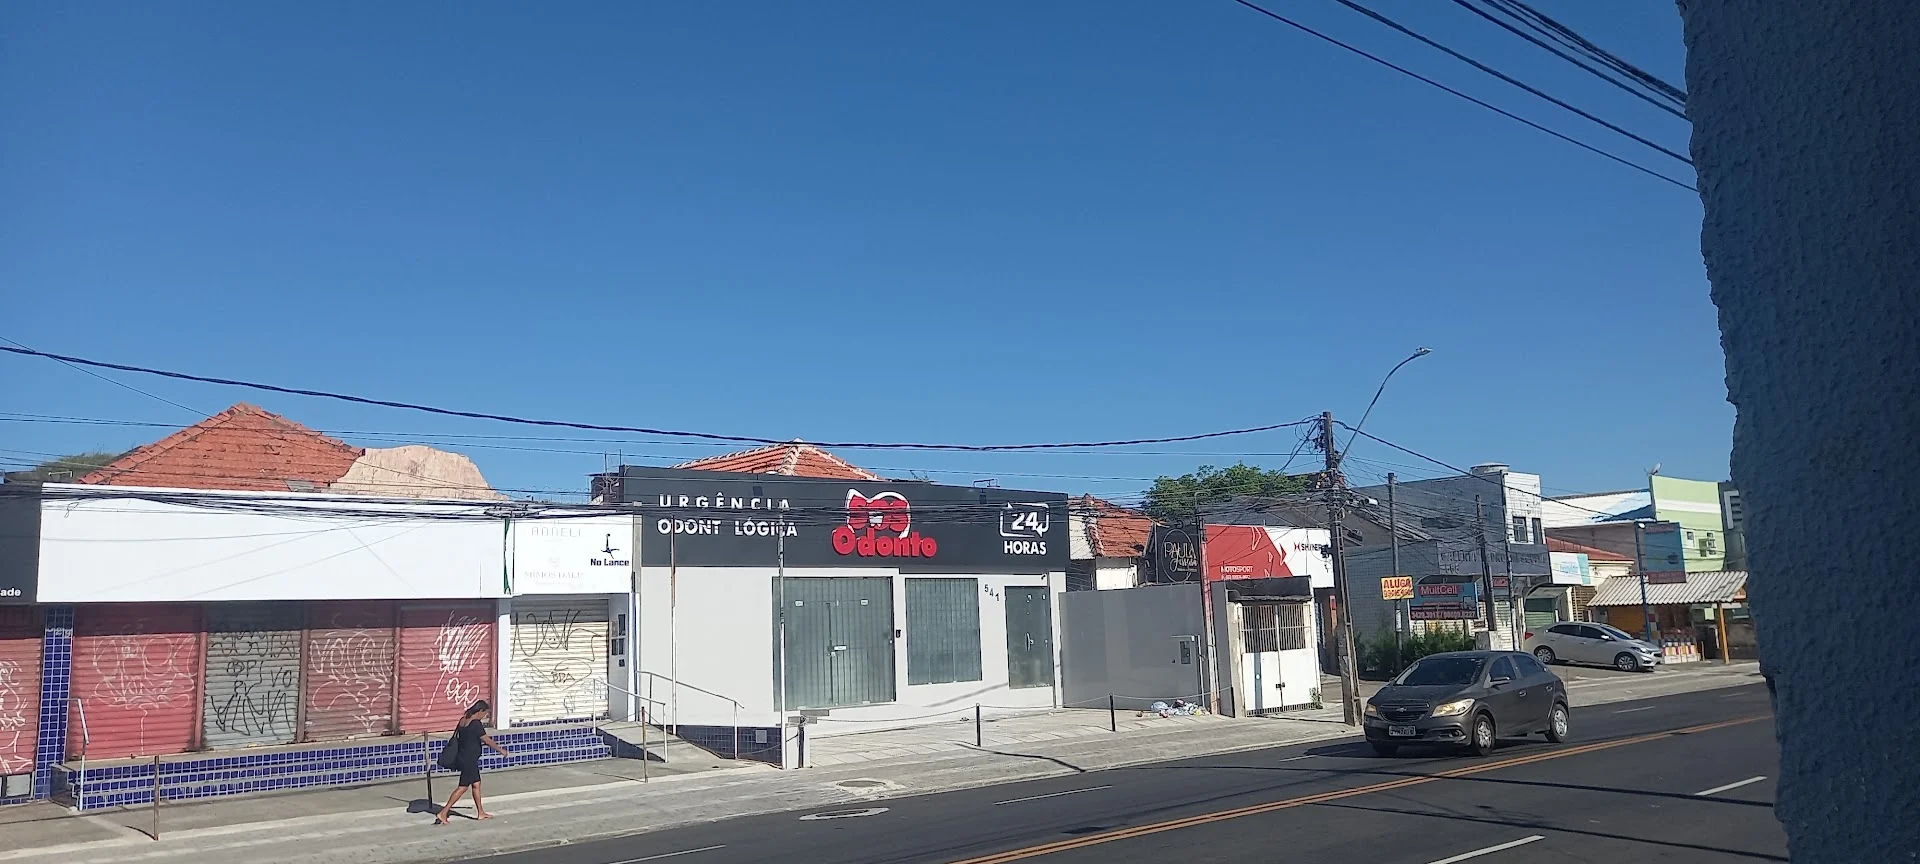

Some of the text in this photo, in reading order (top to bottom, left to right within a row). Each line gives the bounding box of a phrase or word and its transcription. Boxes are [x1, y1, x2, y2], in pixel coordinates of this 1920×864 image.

[659, 492, 790, 511] URGÊNCIA
[1011, 511, 1039, 530] 24
[831, 526, 938, 558] Odonto
[1004, 540, 1047, 555] HORAS
[590, 558, 630, 566] No Lance
[1384, 578, 1411, 589] ALUGA
[1421, 585, 1458, 595] MultCell
[0, 587, 21, 597] ade
[984, 584, 1000, 601] 541
